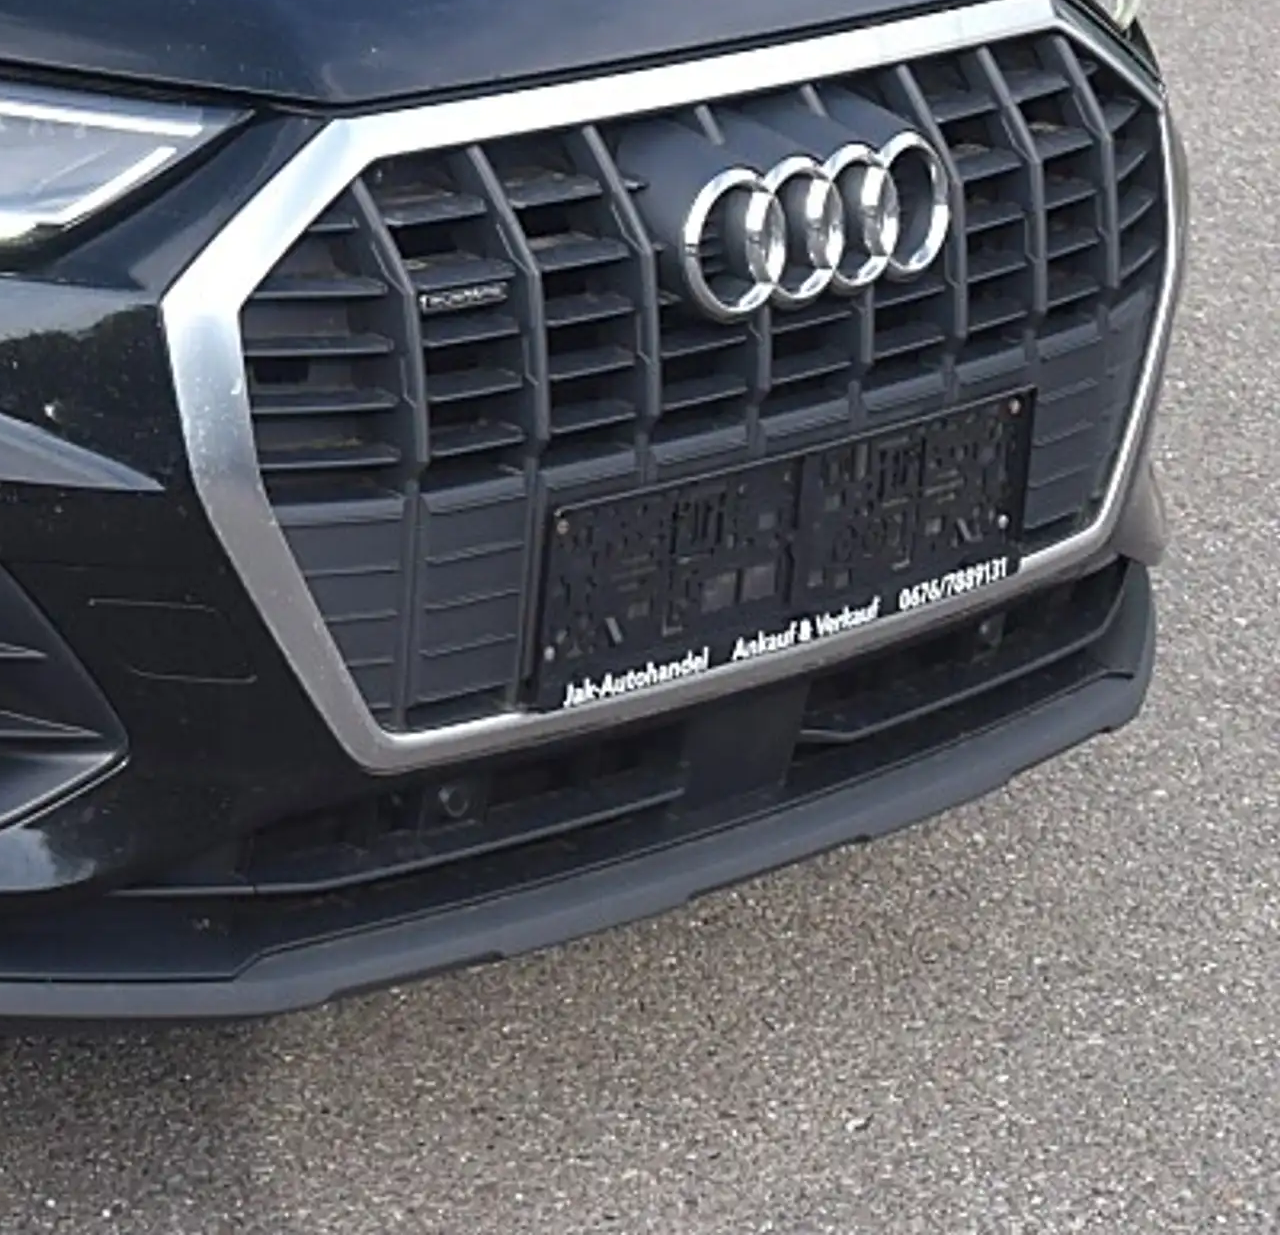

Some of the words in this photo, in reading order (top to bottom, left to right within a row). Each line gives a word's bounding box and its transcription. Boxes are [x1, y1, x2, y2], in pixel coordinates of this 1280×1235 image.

[563, 646, 710, 707] Jak-Autohandel
[732, 620, 798, 660] Ankauf
[798, 618, 814, 641] &
[816, 595, 881, 636] Verkauf
